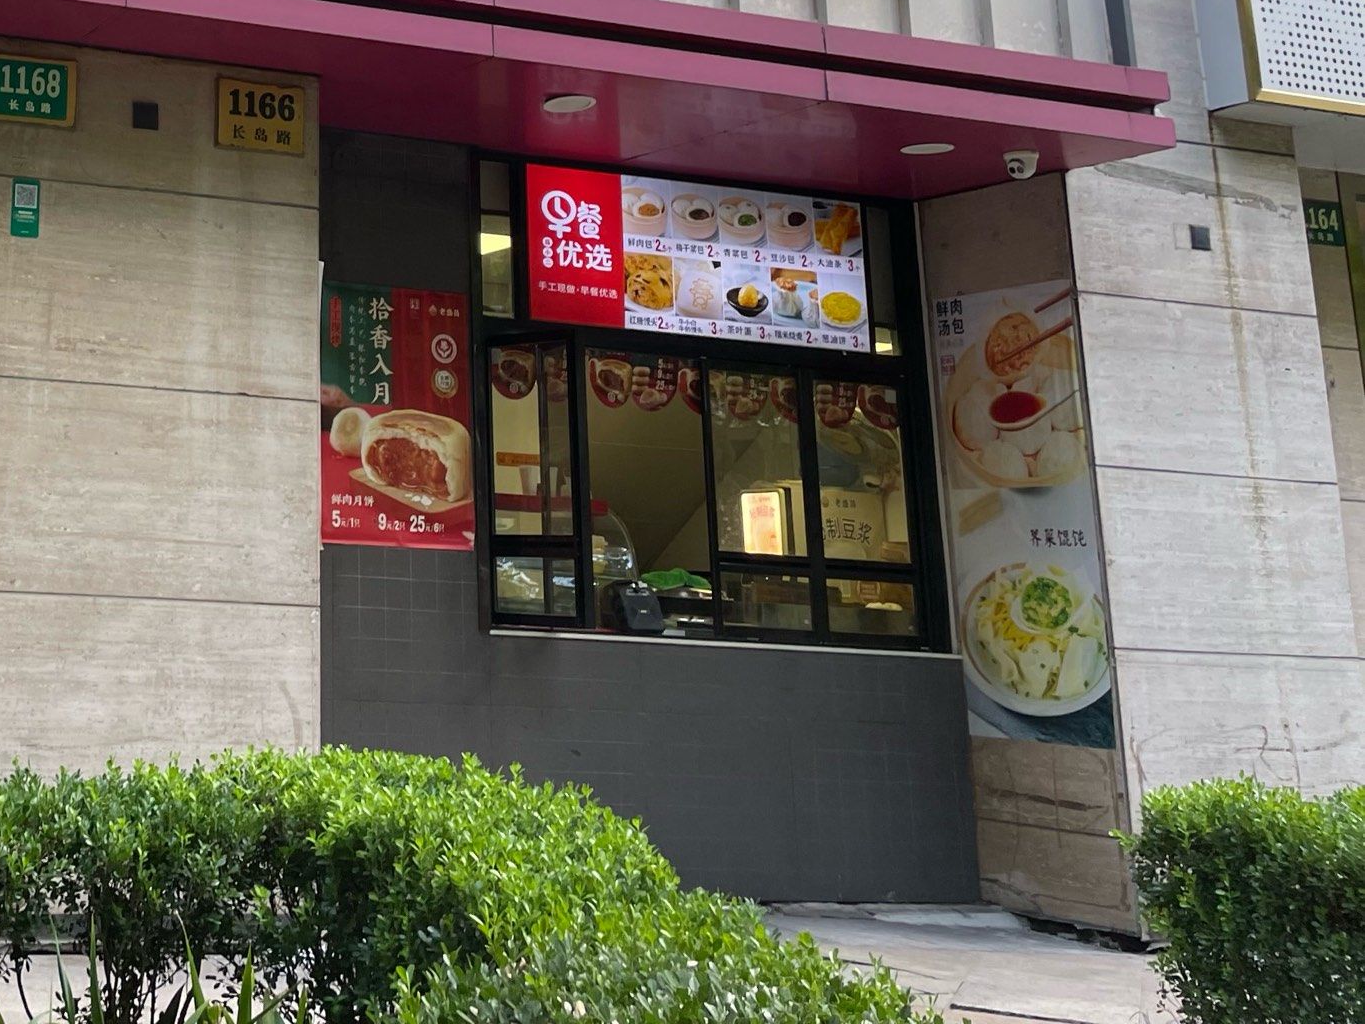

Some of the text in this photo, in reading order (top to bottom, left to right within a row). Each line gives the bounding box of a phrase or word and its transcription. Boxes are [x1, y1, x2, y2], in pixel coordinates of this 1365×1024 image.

[0, 63, 62, 99] 1168
[7, 98, 52, 115] 长岛路
[228, 88, 296, 123] 1166
[232, 123, 292, 146] 长岛路
[541, 190, 603, 240] 早餐
[1306, 206, 1339, 231] 164
[556, 239, 613, 272] 优选
[368, 296, 395, 406] 拾香入月
[331, 493, 375, 508] 鲜肉月饼
[822, 517, 873, 546] 制豆浆
